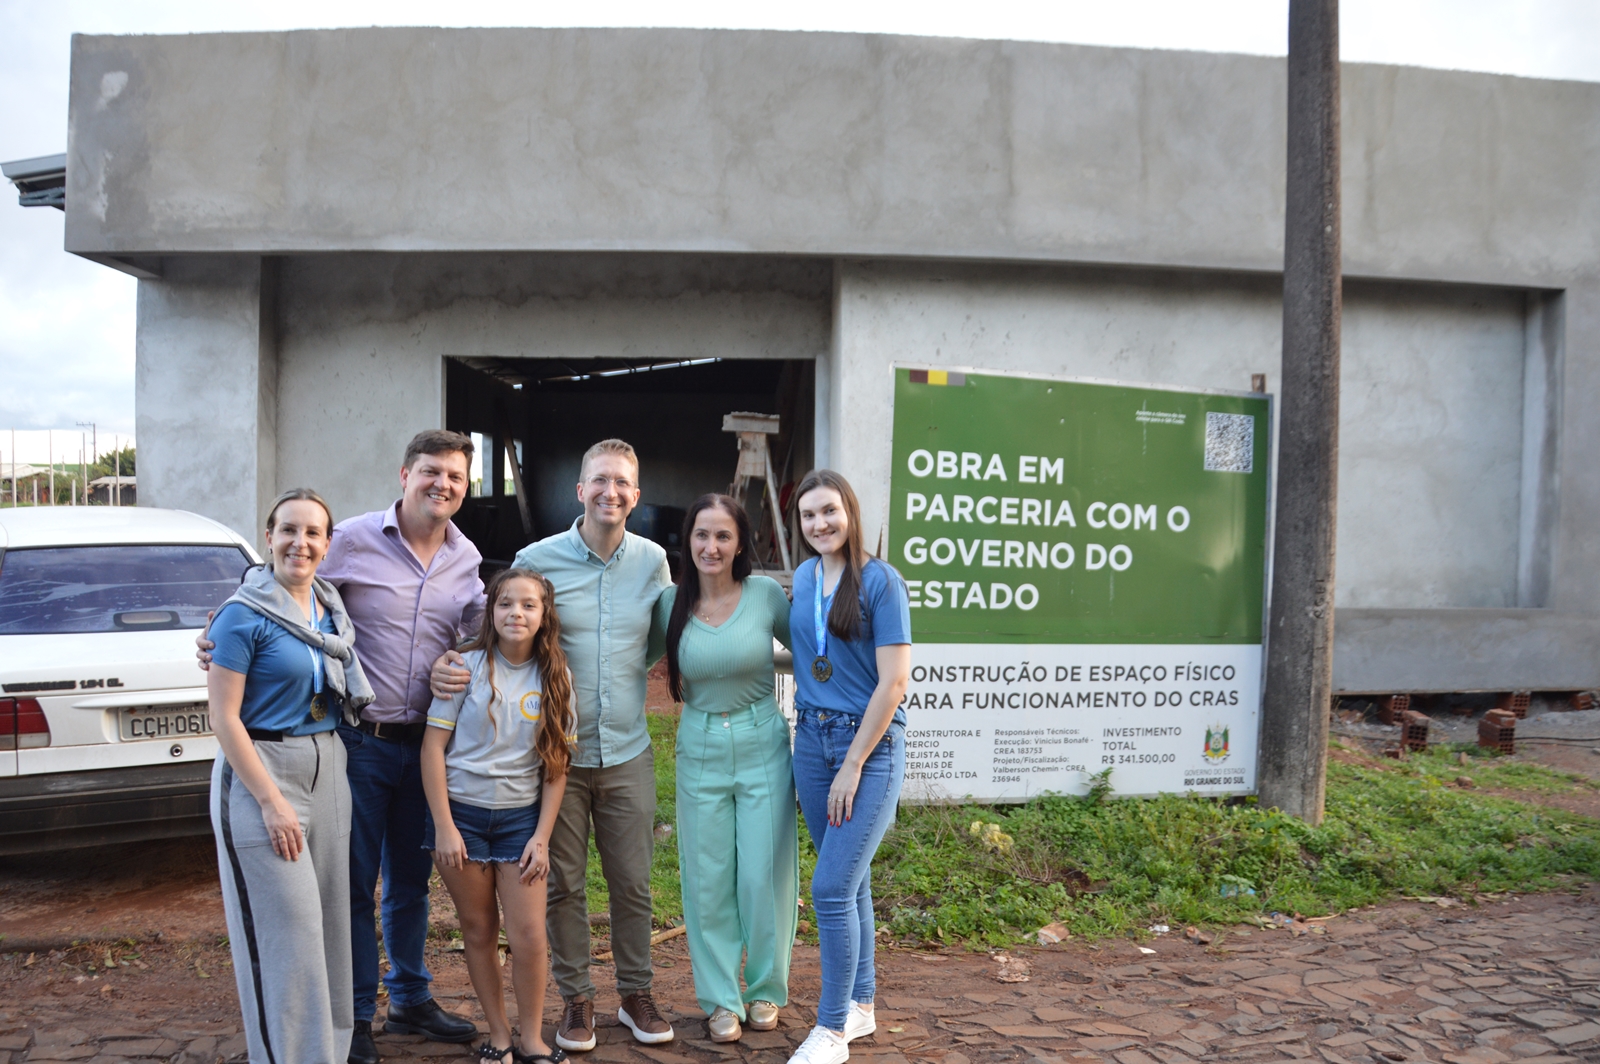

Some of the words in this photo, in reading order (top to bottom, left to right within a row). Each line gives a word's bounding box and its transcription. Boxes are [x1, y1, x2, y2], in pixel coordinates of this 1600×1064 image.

[908, 449, 1007, 482] OBRA
[1018, 455, 1064, 485] EM
[906, 493, 1076, 528] PARCERIA
[1086, 501, 1157, 531] COM
[1167, 505, 1190, 533] O
[903, 536, 1075, 570] GOVERNO
[1085, 544, 1133, 571] DO
[908, 580, 1039, 611] ESTADO
[908, 661, 1047, 685] ONSTRUÇÃO
[1055, 666, 1081, 682] DE
[1089, 665, 1167, 684] ESPAÇO
[1174, 661, 1236, 681] FÍSICO
[962, 691, 1147, 709] FUNCIONAMENTO
[1154, 691, 1182, 707] DO
[1189, 690, 1239, 706] CRAS
[131, 714, 212, 737] CCH·061
[906, 730, 973, 738] CONSTRUTORA
[994, 728, 1044, 736] Responsáveis
[1103, 727, 1182, 737] INVESTIMENTO
[994, 738, 1032, 746] Execução:
[1102, 741, 1137, 750] TOTAL
[905, 751, 940, 759] REJISTA
[1101, 755, 1115, 764] R$
[1118, 753, 1176, 764] 341.500,00
[1065, 764, 1086, 772] CREA
[904, 770, 952, 779] NSTRUÇÃO
[1184, 778, 1195, 786] RIO
[1196, 777, 1222, 785] GRANDE
[1233, 776, 1245, 784] SUL
